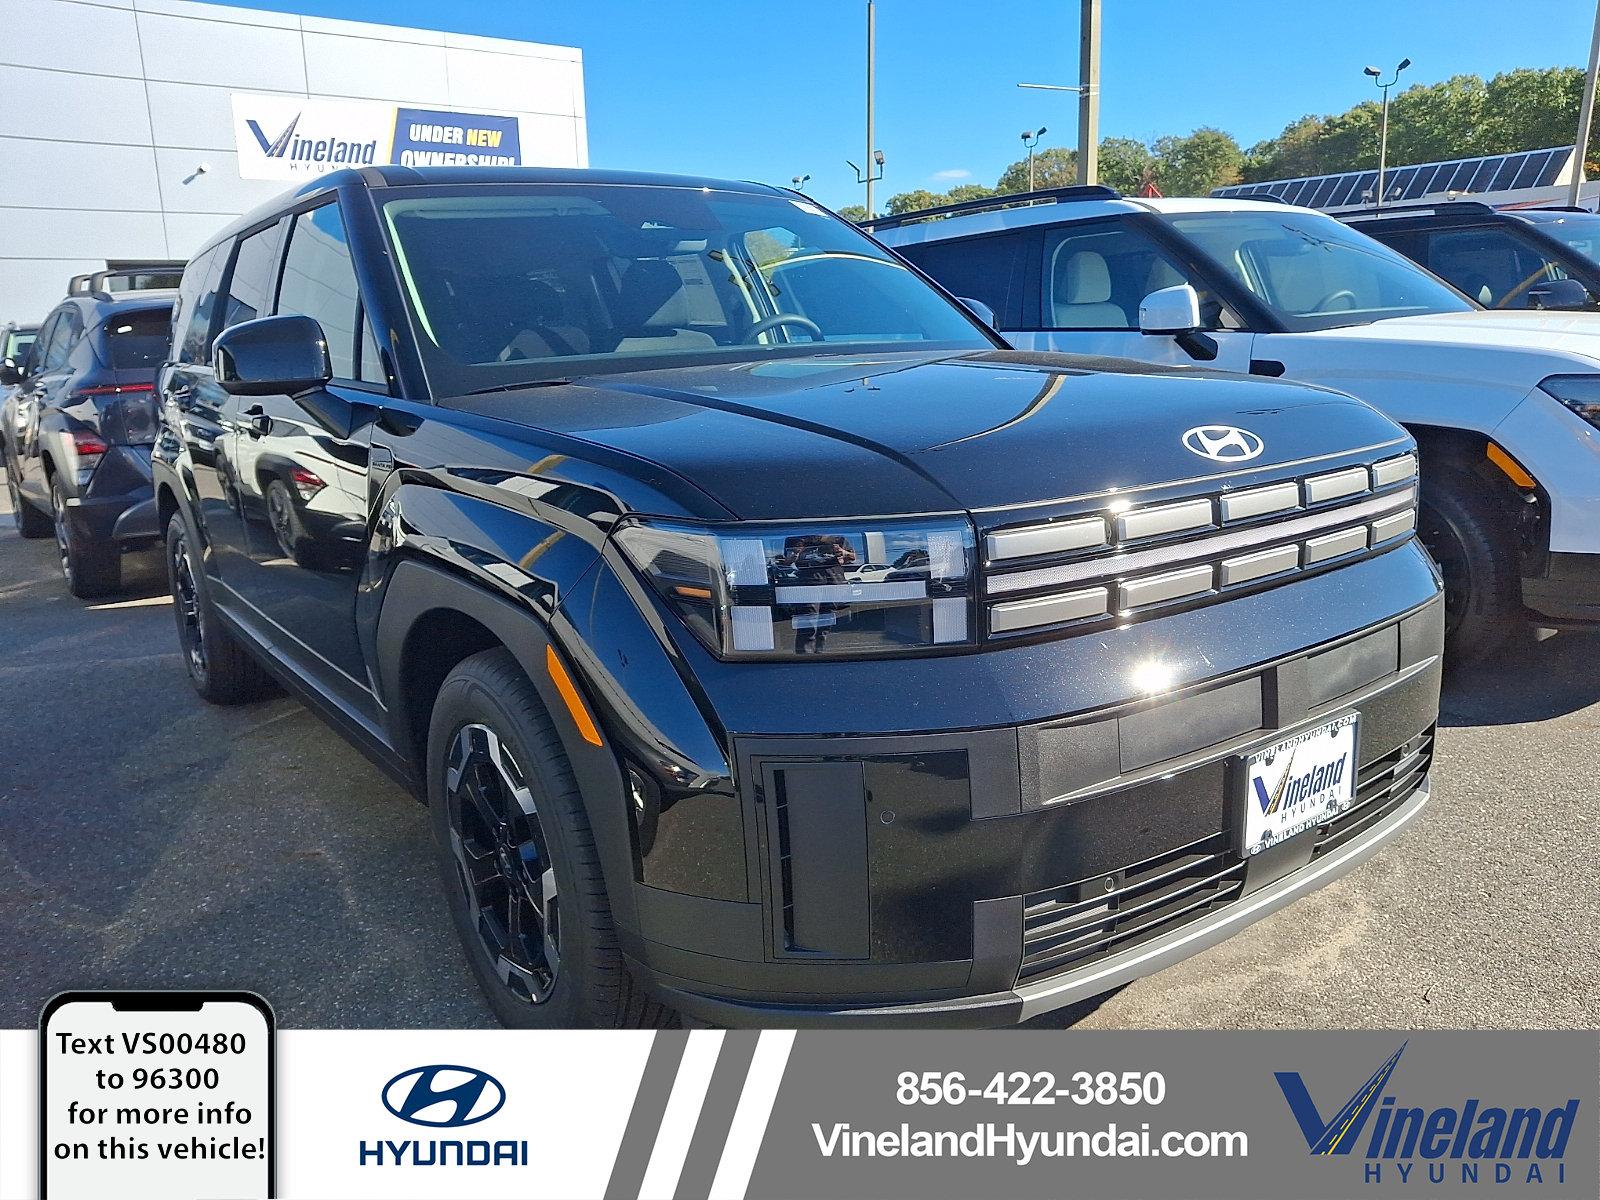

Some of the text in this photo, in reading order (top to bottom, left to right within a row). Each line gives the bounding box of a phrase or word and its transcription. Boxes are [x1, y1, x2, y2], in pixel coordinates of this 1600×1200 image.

[246, 110, 377, 164] Vineland
[409, 123, 502, 147] UNDER NEW
[1253, 748, 1348, 817] Vineland
[1281, 785, 1342, 823] HYUNDAI
[1264, 805, 1339, 849] VINELAND HYUNDAI
